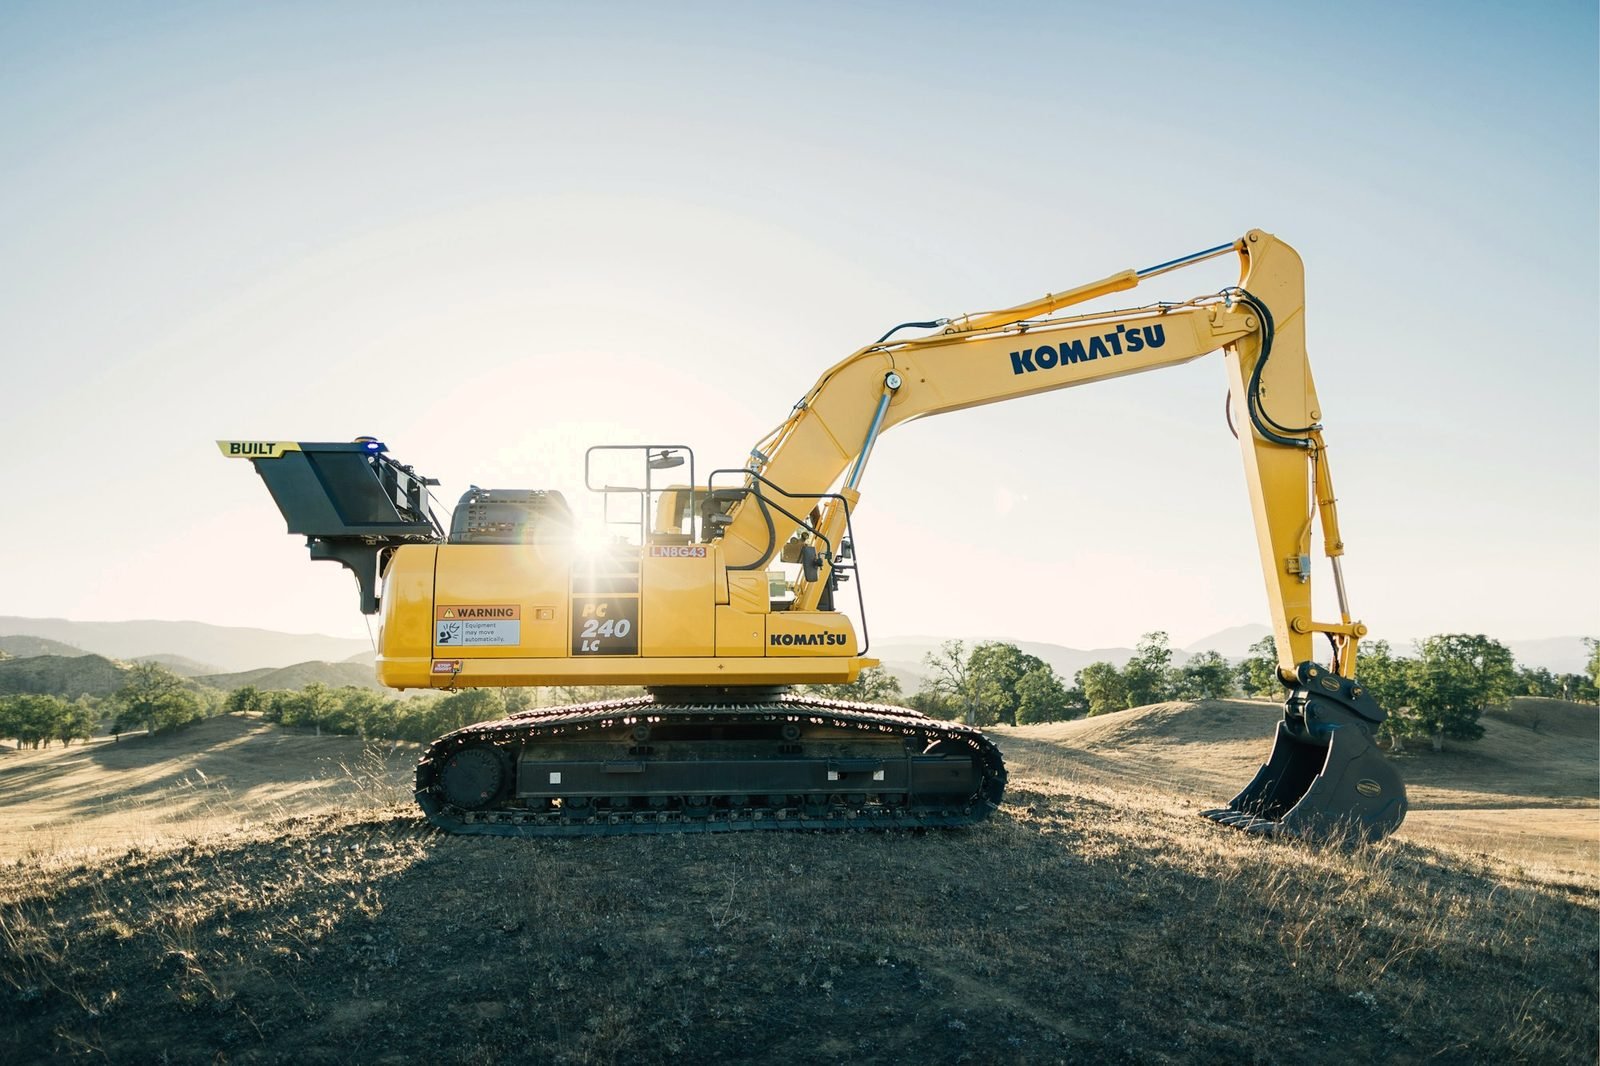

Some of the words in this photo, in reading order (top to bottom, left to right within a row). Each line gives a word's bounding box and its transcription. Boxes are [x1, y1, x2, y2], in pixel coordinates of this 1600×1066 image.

[1009, 323, 1166, 375] KOMATSU
[230, 442, 276, 454] BUILT
[651, 547, 705, 557] LN8G43
[457, 608, 514, 618] WARNING
[582, 603, 608, 617] PC
[580, 619, 631, 638] 240
[770, 631, 847, 646] KOMATSU
[581, 640, 600, 652] LC
